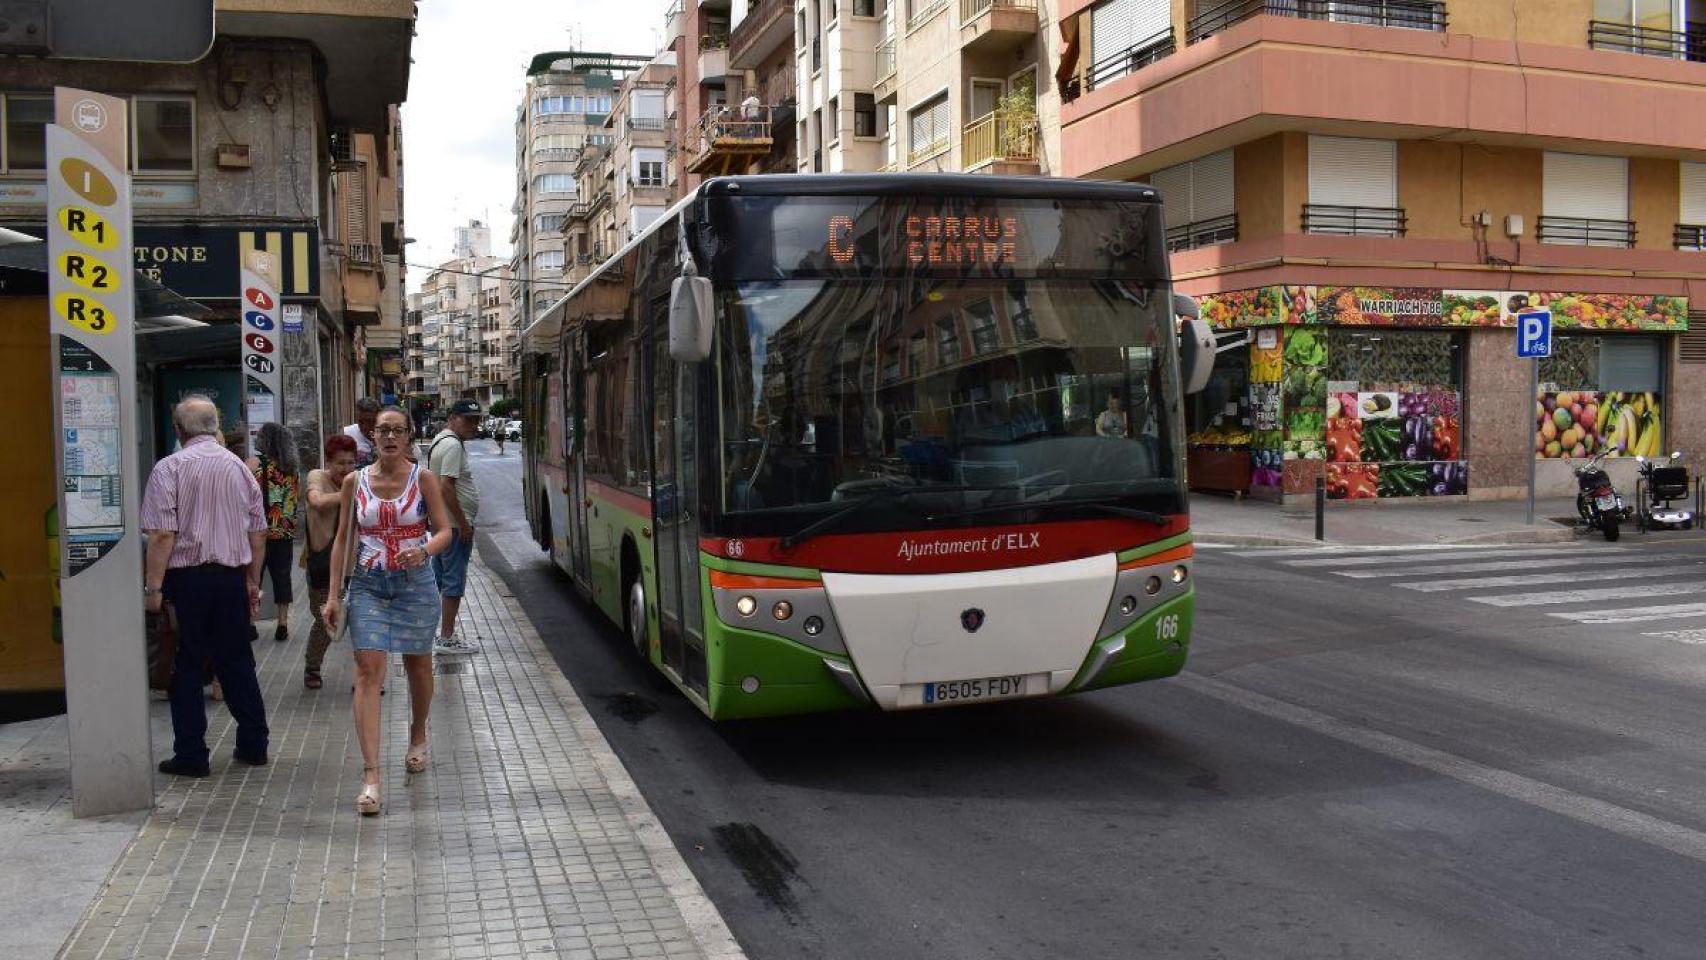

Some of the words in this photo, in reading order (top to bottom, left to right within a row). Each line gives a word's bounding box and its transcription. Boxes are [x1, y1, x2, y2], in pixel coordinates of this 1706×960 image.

[906, 215, 1017, 237] CARRUS
[829, 215, 854, 262] C
[908, 241, 1017, 263] CENTRE
[255, 292, 266, 305] A
[1360, 299, 1420, 315] WARRIACH
[255, 315, 264, 327] C
[254, 337, 264, 348] G
[1523, 318, 1543, 352] P
[729, 541, 743, 556] 66
[897, 537, 988, 561] Ajuntament
[1156, 614, 1178, 640] 166
[937, 680, 982, 701] 6505
[987, 675, 1022, 697] FDY
